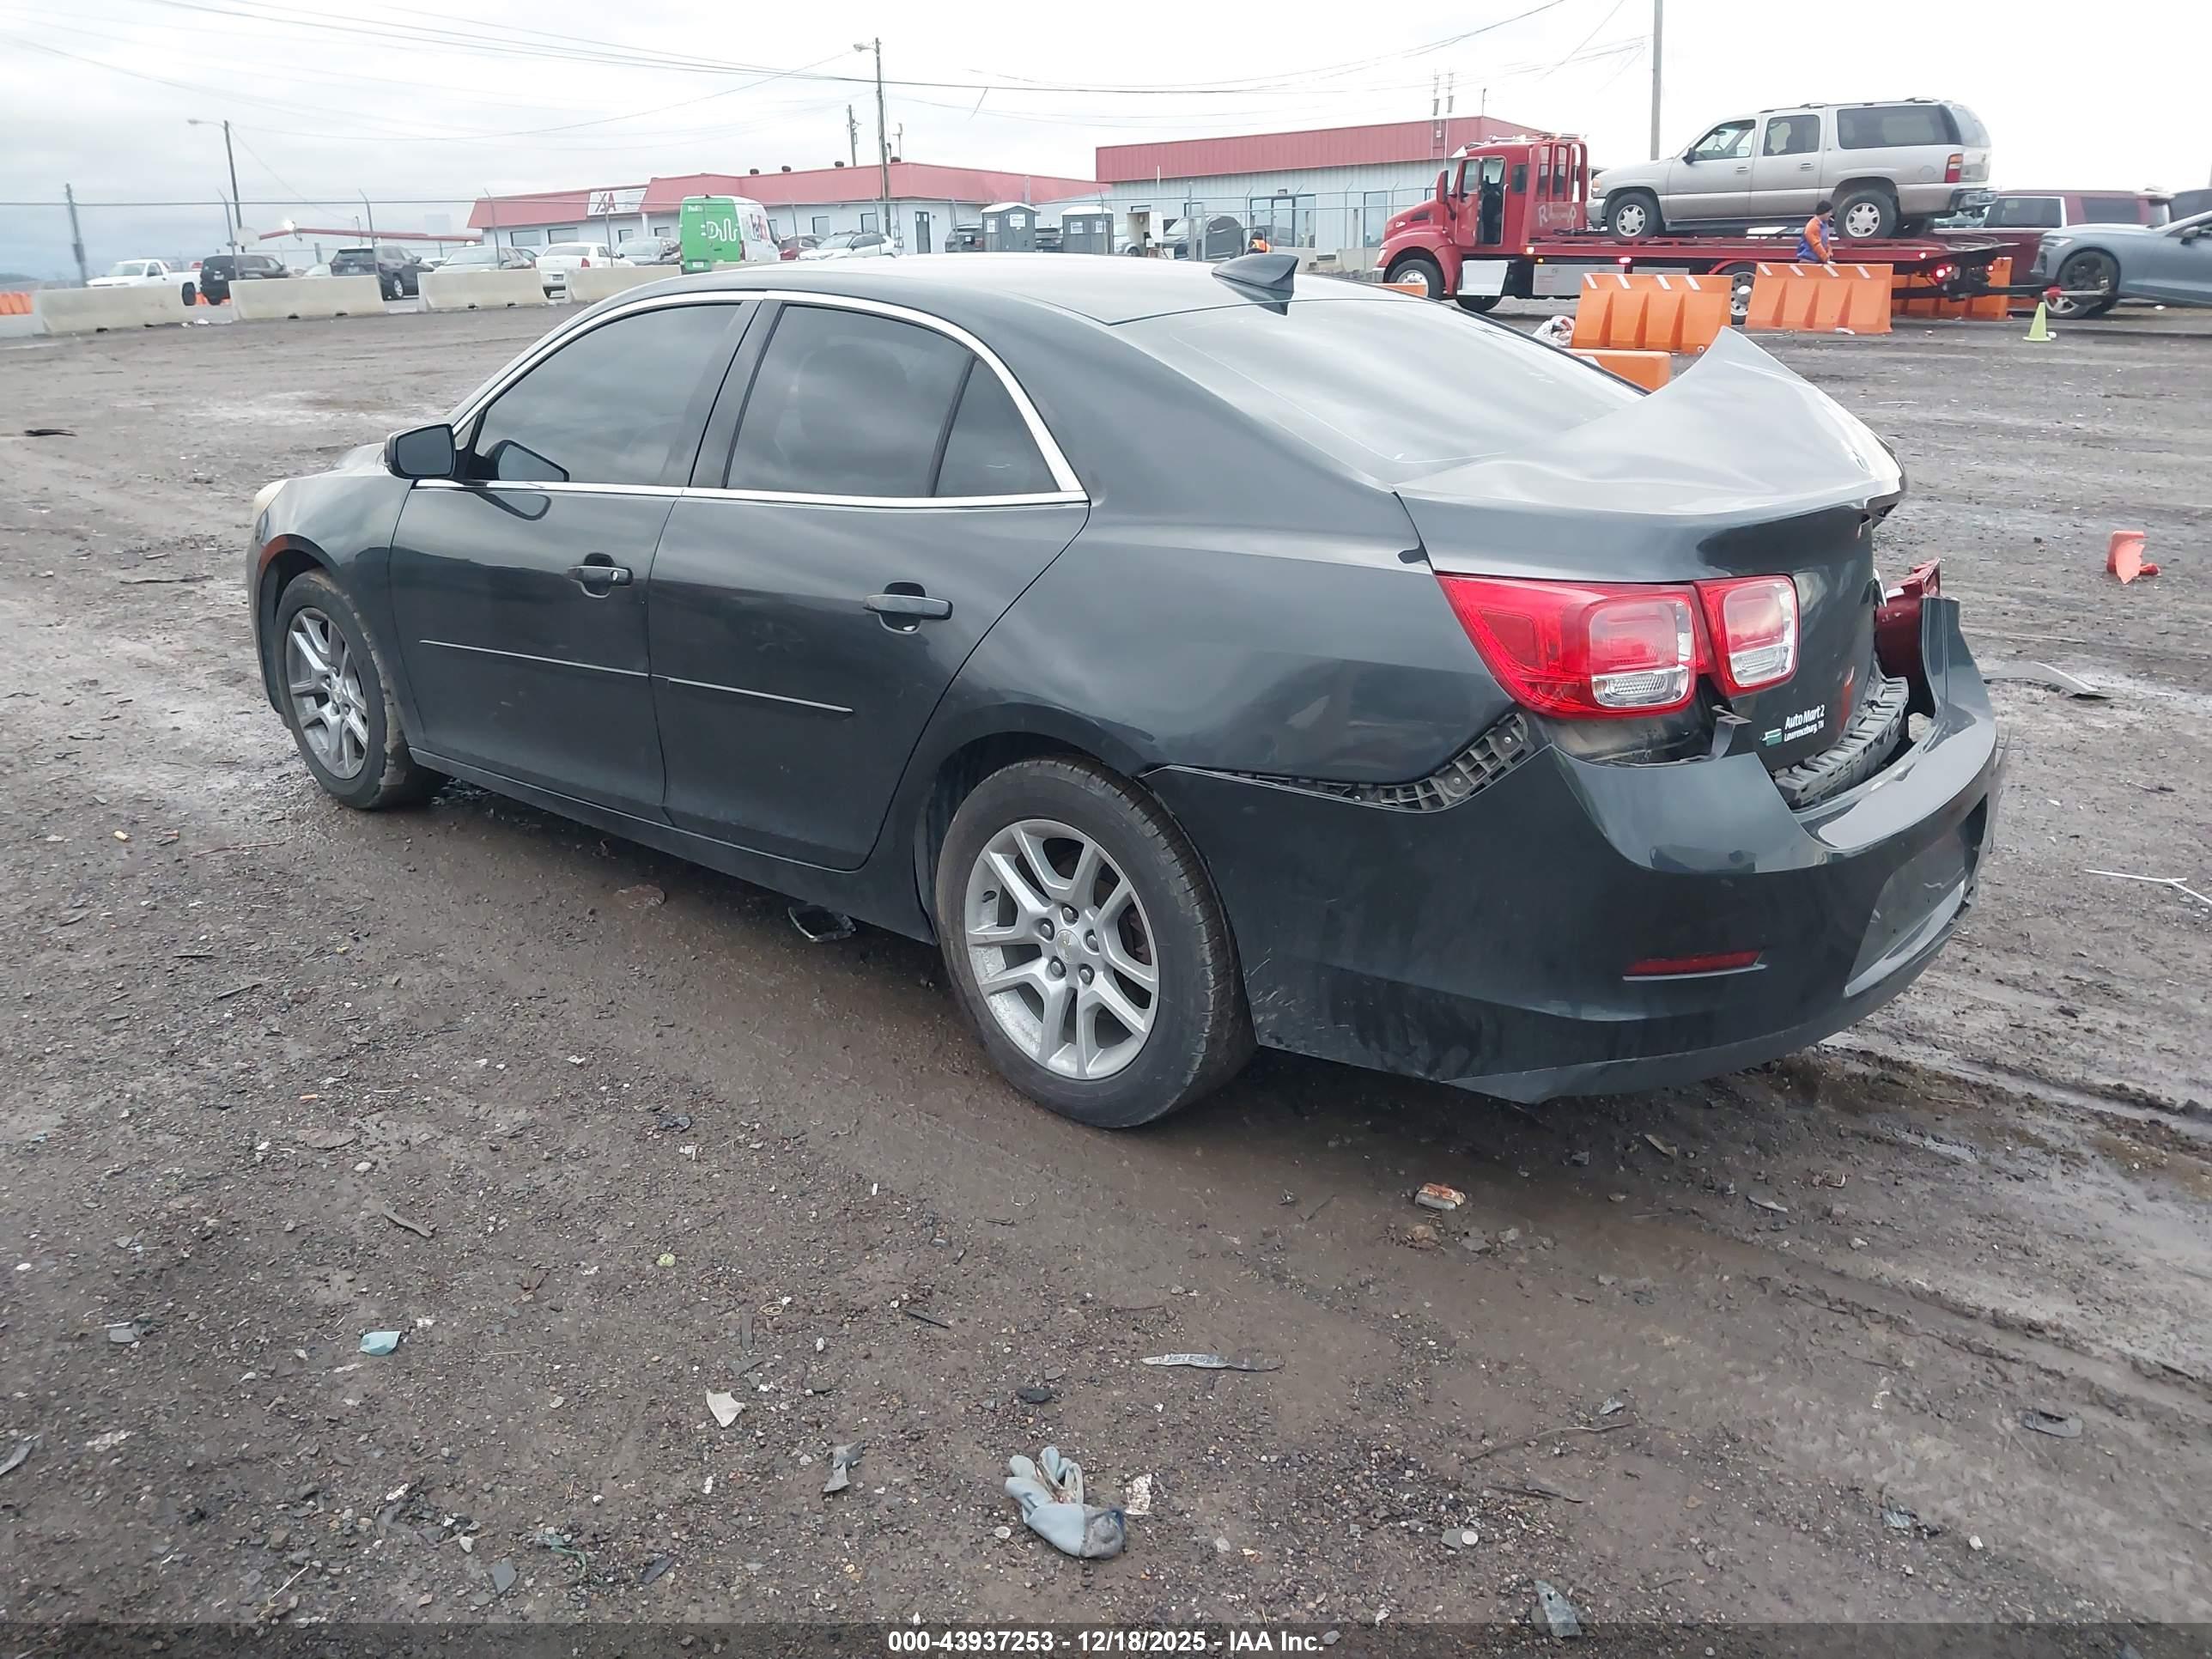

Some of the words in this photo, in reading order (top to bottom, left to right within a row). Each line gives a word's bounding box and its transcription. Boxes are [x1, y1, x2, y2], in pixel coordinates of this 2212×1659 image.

[1784, 714, 1803, 730] Auto
[1803, 705, 1820, 724] Mart
[1820, 704, 1826, 717] 2
[1818, 720, 1825, 729] TN
